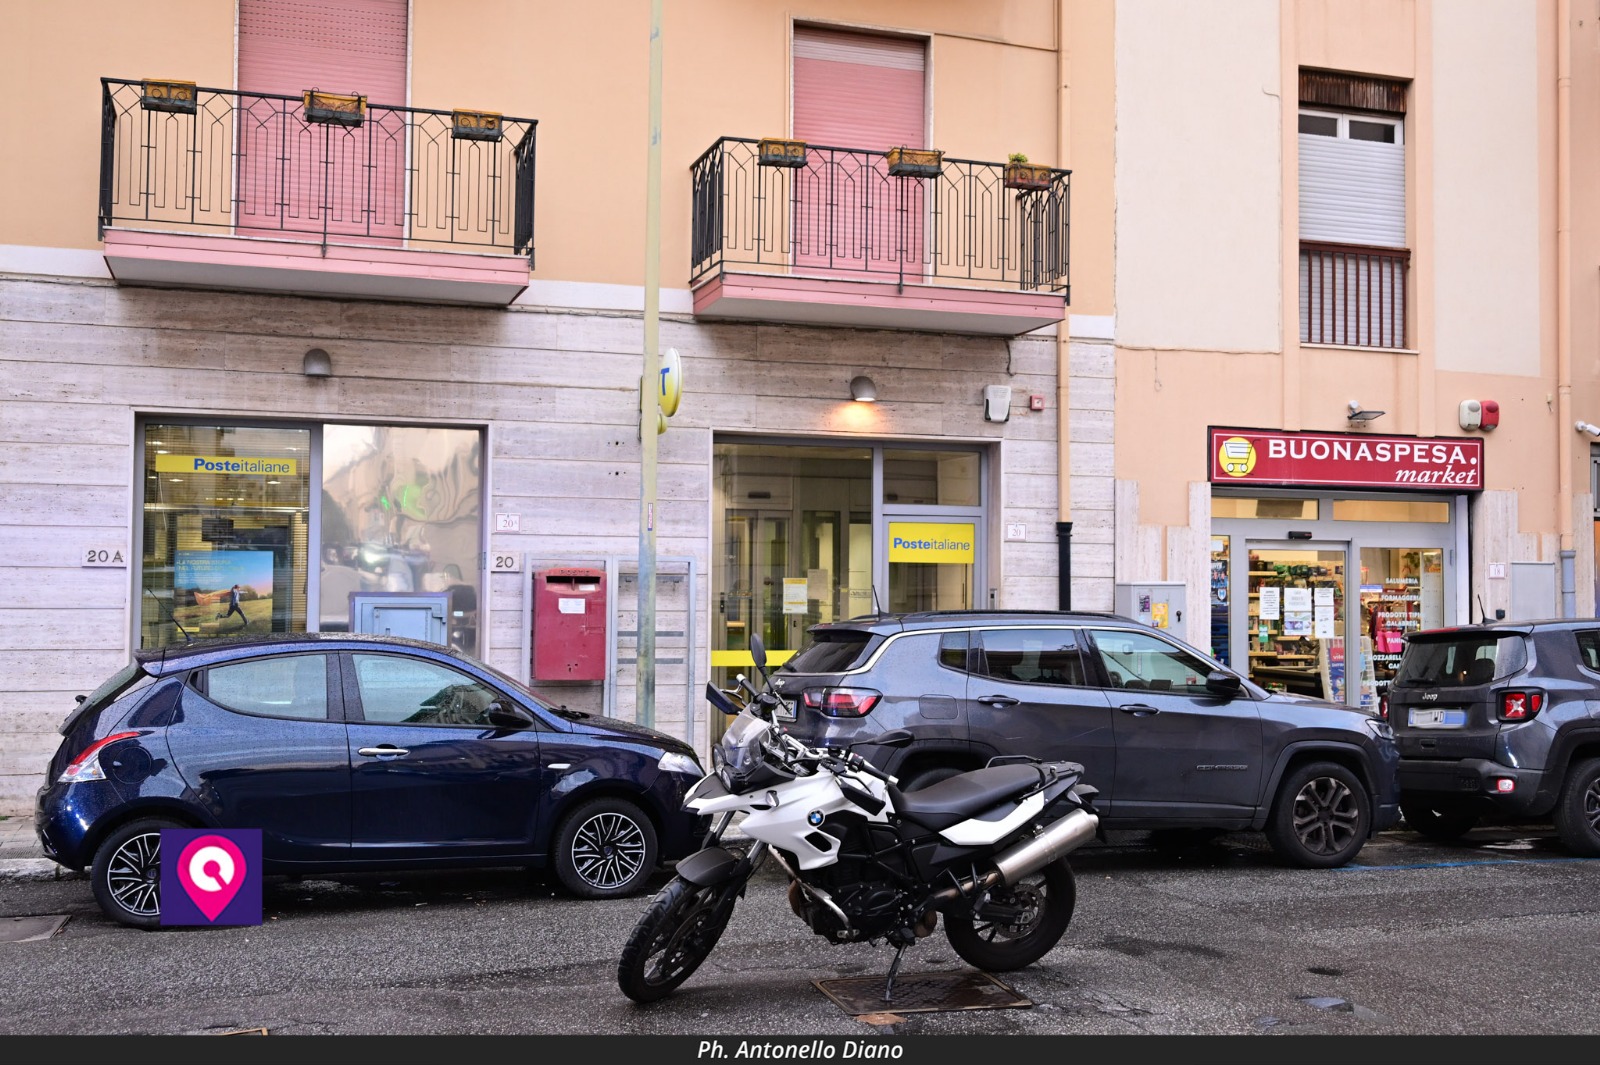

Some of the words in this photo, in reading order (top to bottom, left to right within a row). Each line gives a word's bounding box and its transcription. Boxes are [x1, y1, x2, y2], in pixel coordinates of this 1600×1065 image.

[193, 458, 290, 473] Posteitaliane
[1395, 465, 1477, 484] market
[1012, 528, 1021, 537] 20
[893, 537, 970, 551] Posteitaliane
[87, 549, 109, 563] 20
[495, 556, 514, 568] 20
[1422, 692, 1438, 701] Jeep
